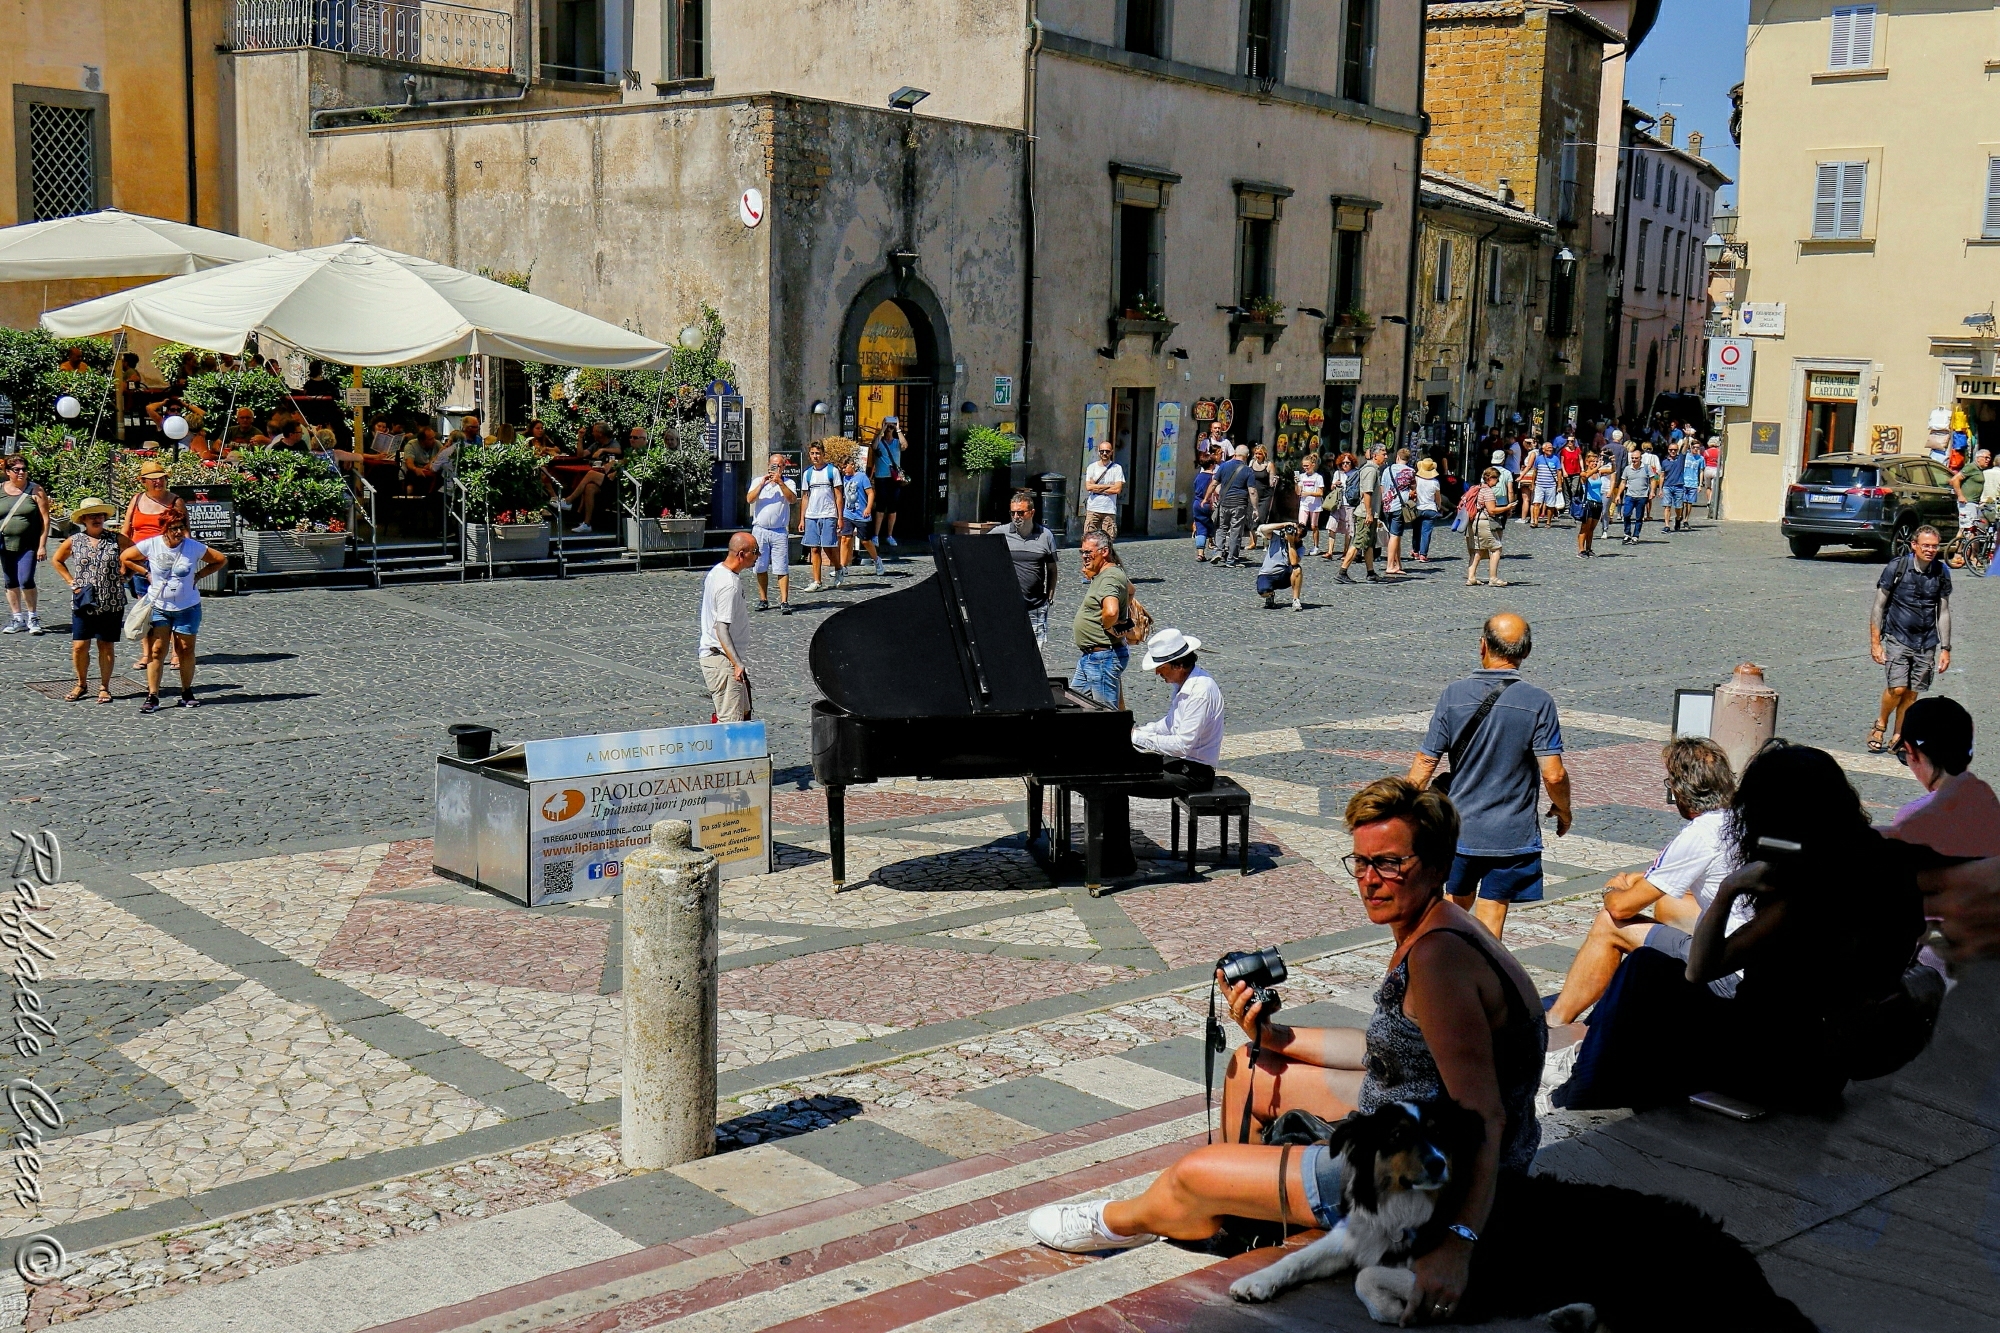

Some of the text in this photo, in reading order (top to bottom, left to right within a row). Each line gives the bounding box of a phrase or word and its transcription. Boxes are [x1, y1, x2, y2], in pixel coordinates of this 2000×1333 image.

[1815, 376, 1856, 386] CERAMICHE
[1961, 381, 2000, 395] OUTL
[1814, 387, 1856, 397] CARTOLINE
[1475, 694, 1497, 721] BASILE
[586, 740, 713, 763] A MOMENT FOR YOU
[591, 770, 756, 803] PAOLOZANARELLA
[591, 795, 707, 820] Il pianista fuori posto
[550, 833, 577, 843] REGALO
[632, 824, 652, 833] COLLE
[728, 835, 760, 846] diventiamo
[543, 834, 652, 857] www.ilpianistafuori
